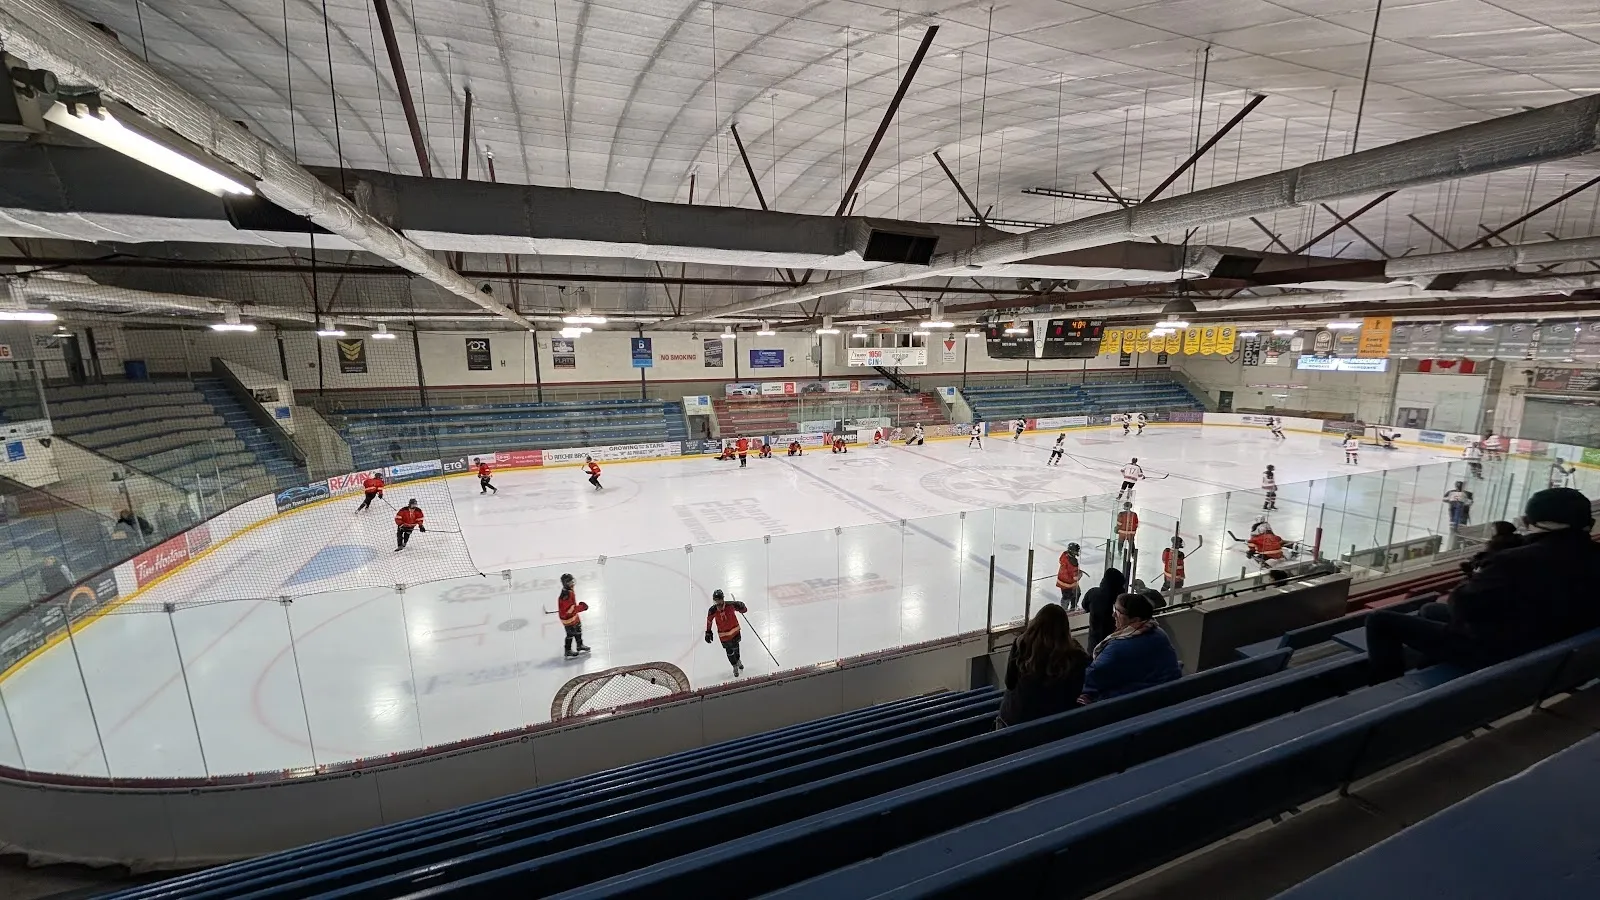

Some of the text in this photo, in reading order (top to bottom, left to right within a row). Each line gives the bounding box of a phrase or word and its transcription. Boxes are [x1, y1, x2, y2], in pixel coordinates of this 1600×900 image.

[467, 341, 486, 350] ADR
[443, 462, 462, 471] ETG
[136, 549, 187, 581] Tim Hortons
